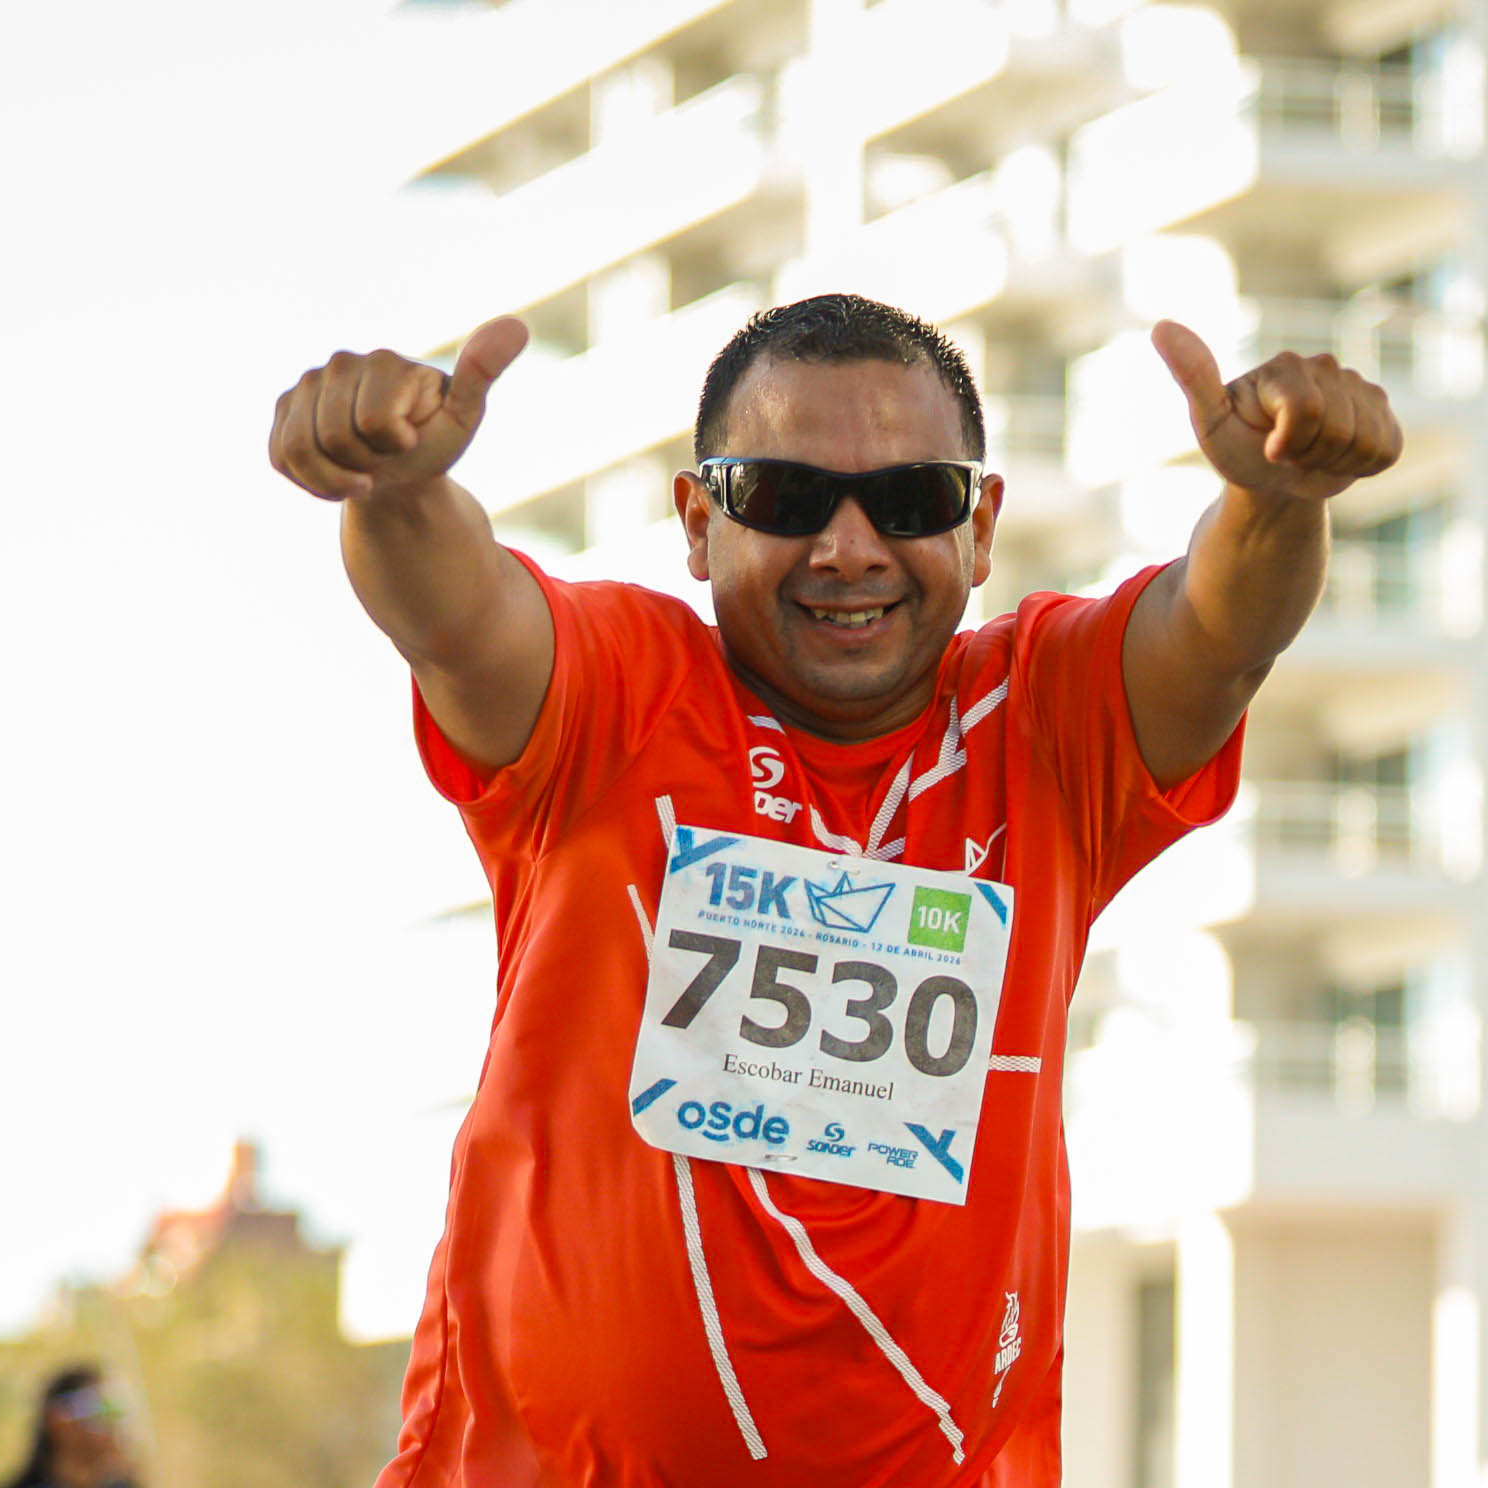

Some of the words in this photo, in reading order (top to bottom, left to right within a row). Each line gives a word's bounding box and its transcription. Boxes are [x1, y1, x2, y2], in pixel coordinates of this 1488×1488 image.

[706, 862, 800, 919] 15K
[698, 910, 740, 926] PUERTO
[743, 918, 778, 933] NORTE
[780, 926, 805, 938] 2026
[815, 931, 860, 948] ROSARIO
[871, 942, 883, 951] 12
[887, 944, 900, 955] DE
[903, 947, 934, 960] ABRIL
[937, 953, 962, 965] 2026
[918, 905, 962, 934] 10K
[660, 928, 979, 1077] 7530
[721, 1053, 803, 1085] Escobar
[807, 1068, 895, 1101] Emanuel
[677, 1101, 790, 1144] osde
[867, 1143, 919, 1160] POWER
